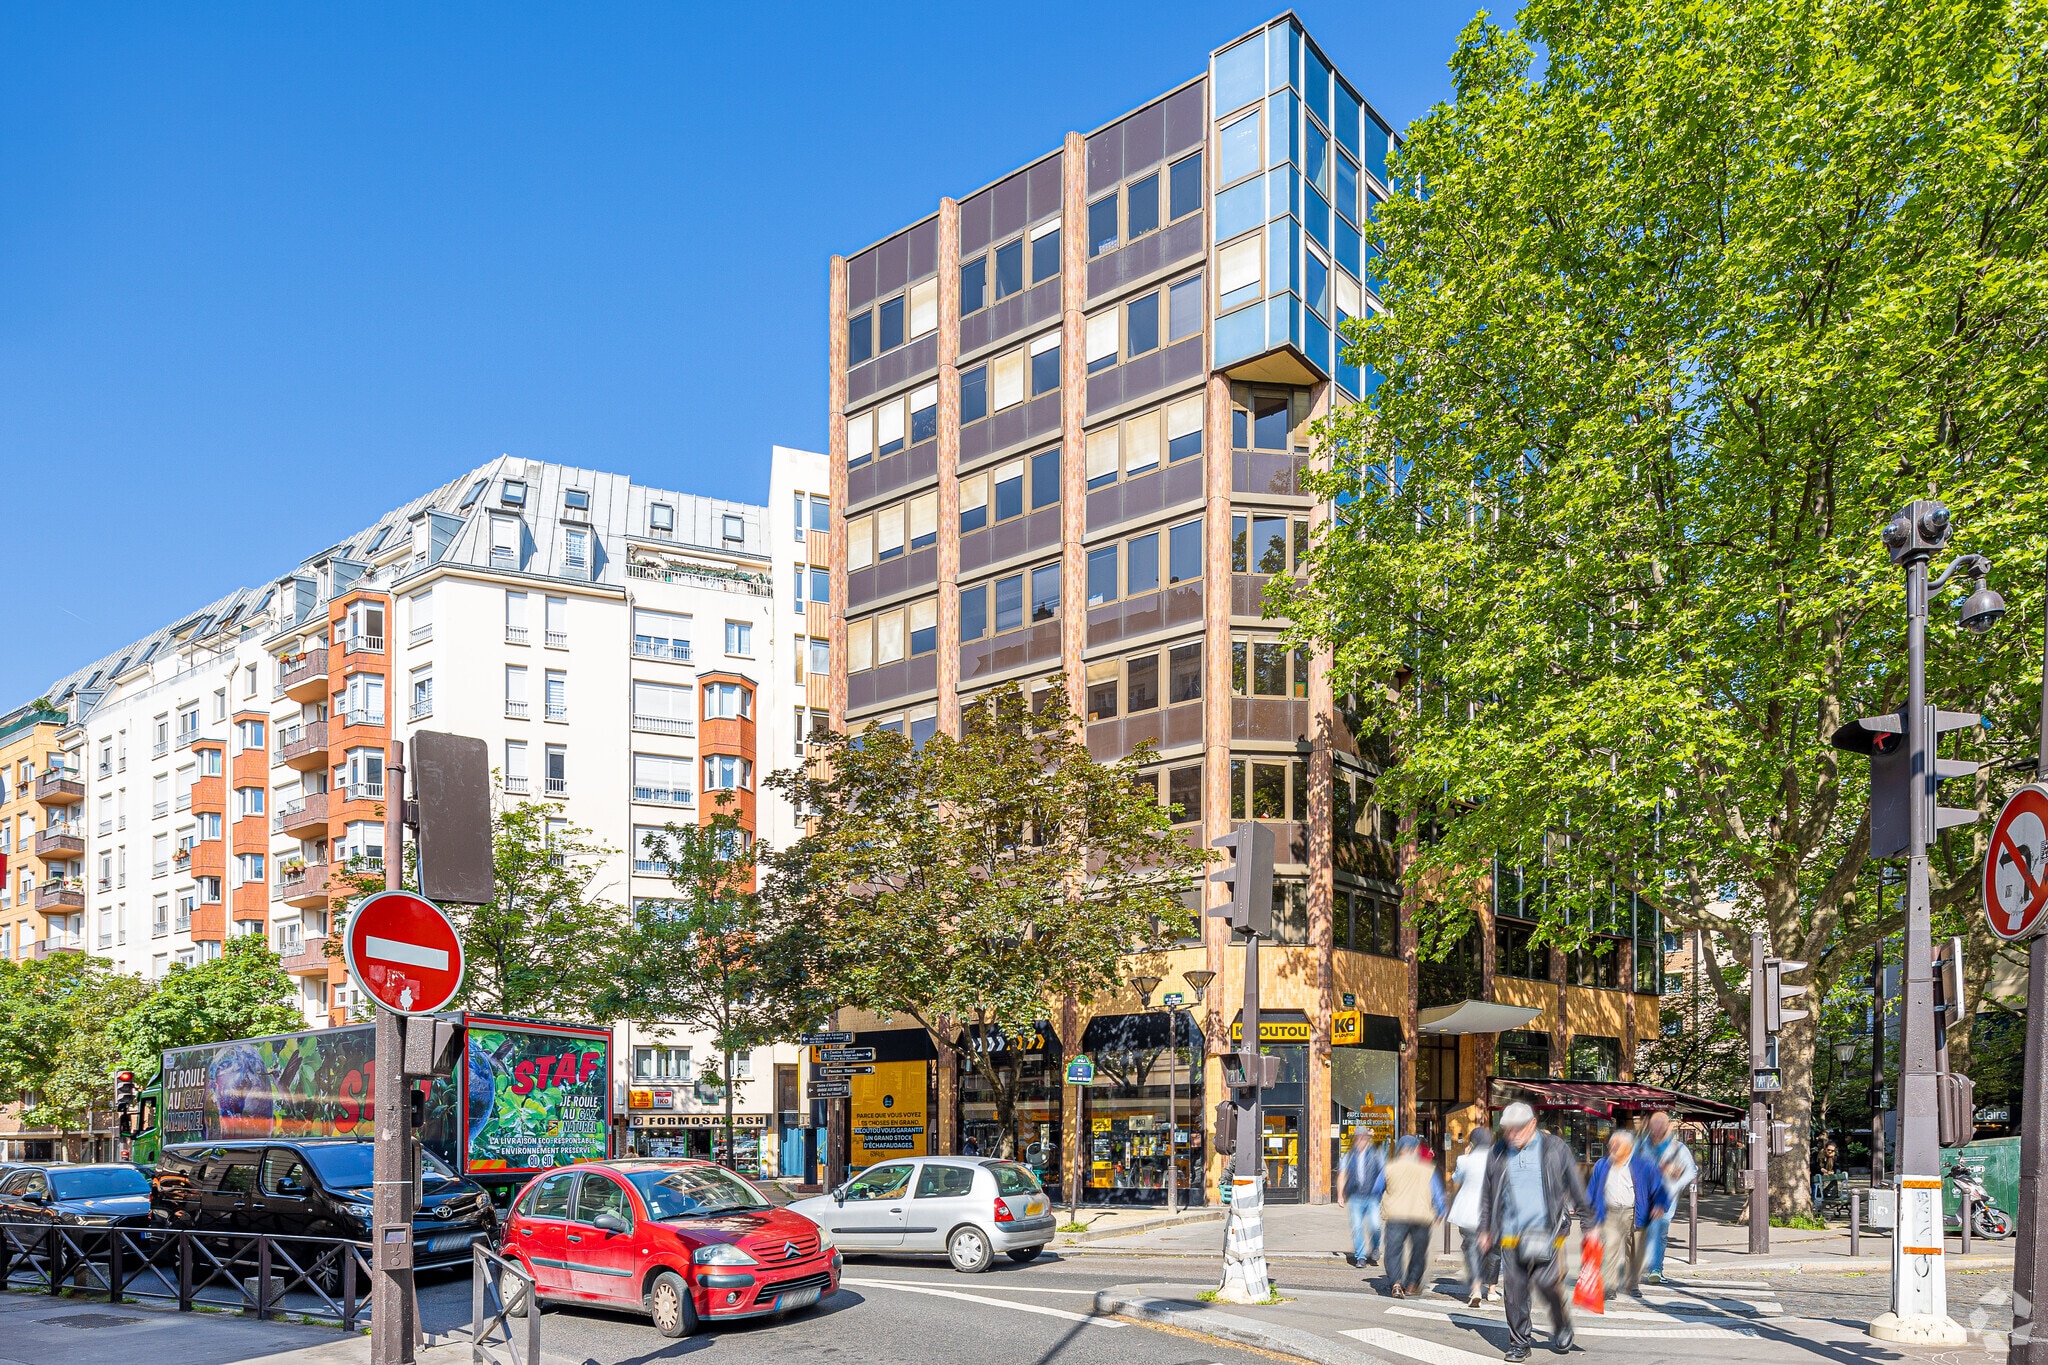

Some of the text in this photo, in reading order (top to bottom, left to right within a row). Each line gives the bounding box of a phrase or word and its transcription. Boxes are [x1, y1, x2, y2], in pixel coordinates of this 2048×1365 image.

[1235, 1026, 1308, 1037] KOUTOU
[167, 1068, 206, 1090] JE ROULE
[511, 1052, 600, 1095] STAF
[167, 1088, 206, 1110] AU GAZ
[562, 1095, 598, 1108] JE ROULE
[562, 1108, 597, 1121] AU GAZ
[1975, 1109, 2008, 1120] Claire
[167, 1111, 204, 1132] NATUREL
[562, 1121, 597, 1133] NATUREL
[489, 1137, 500, 1145] LA
[500, 1137, 537, 1145] LIVRAISON
[501, 1146, 560, 1155] ENVIRONNEMENT
[529, 1155, 540, 1167] 80
[543, 1155, 553, 1167] 90
